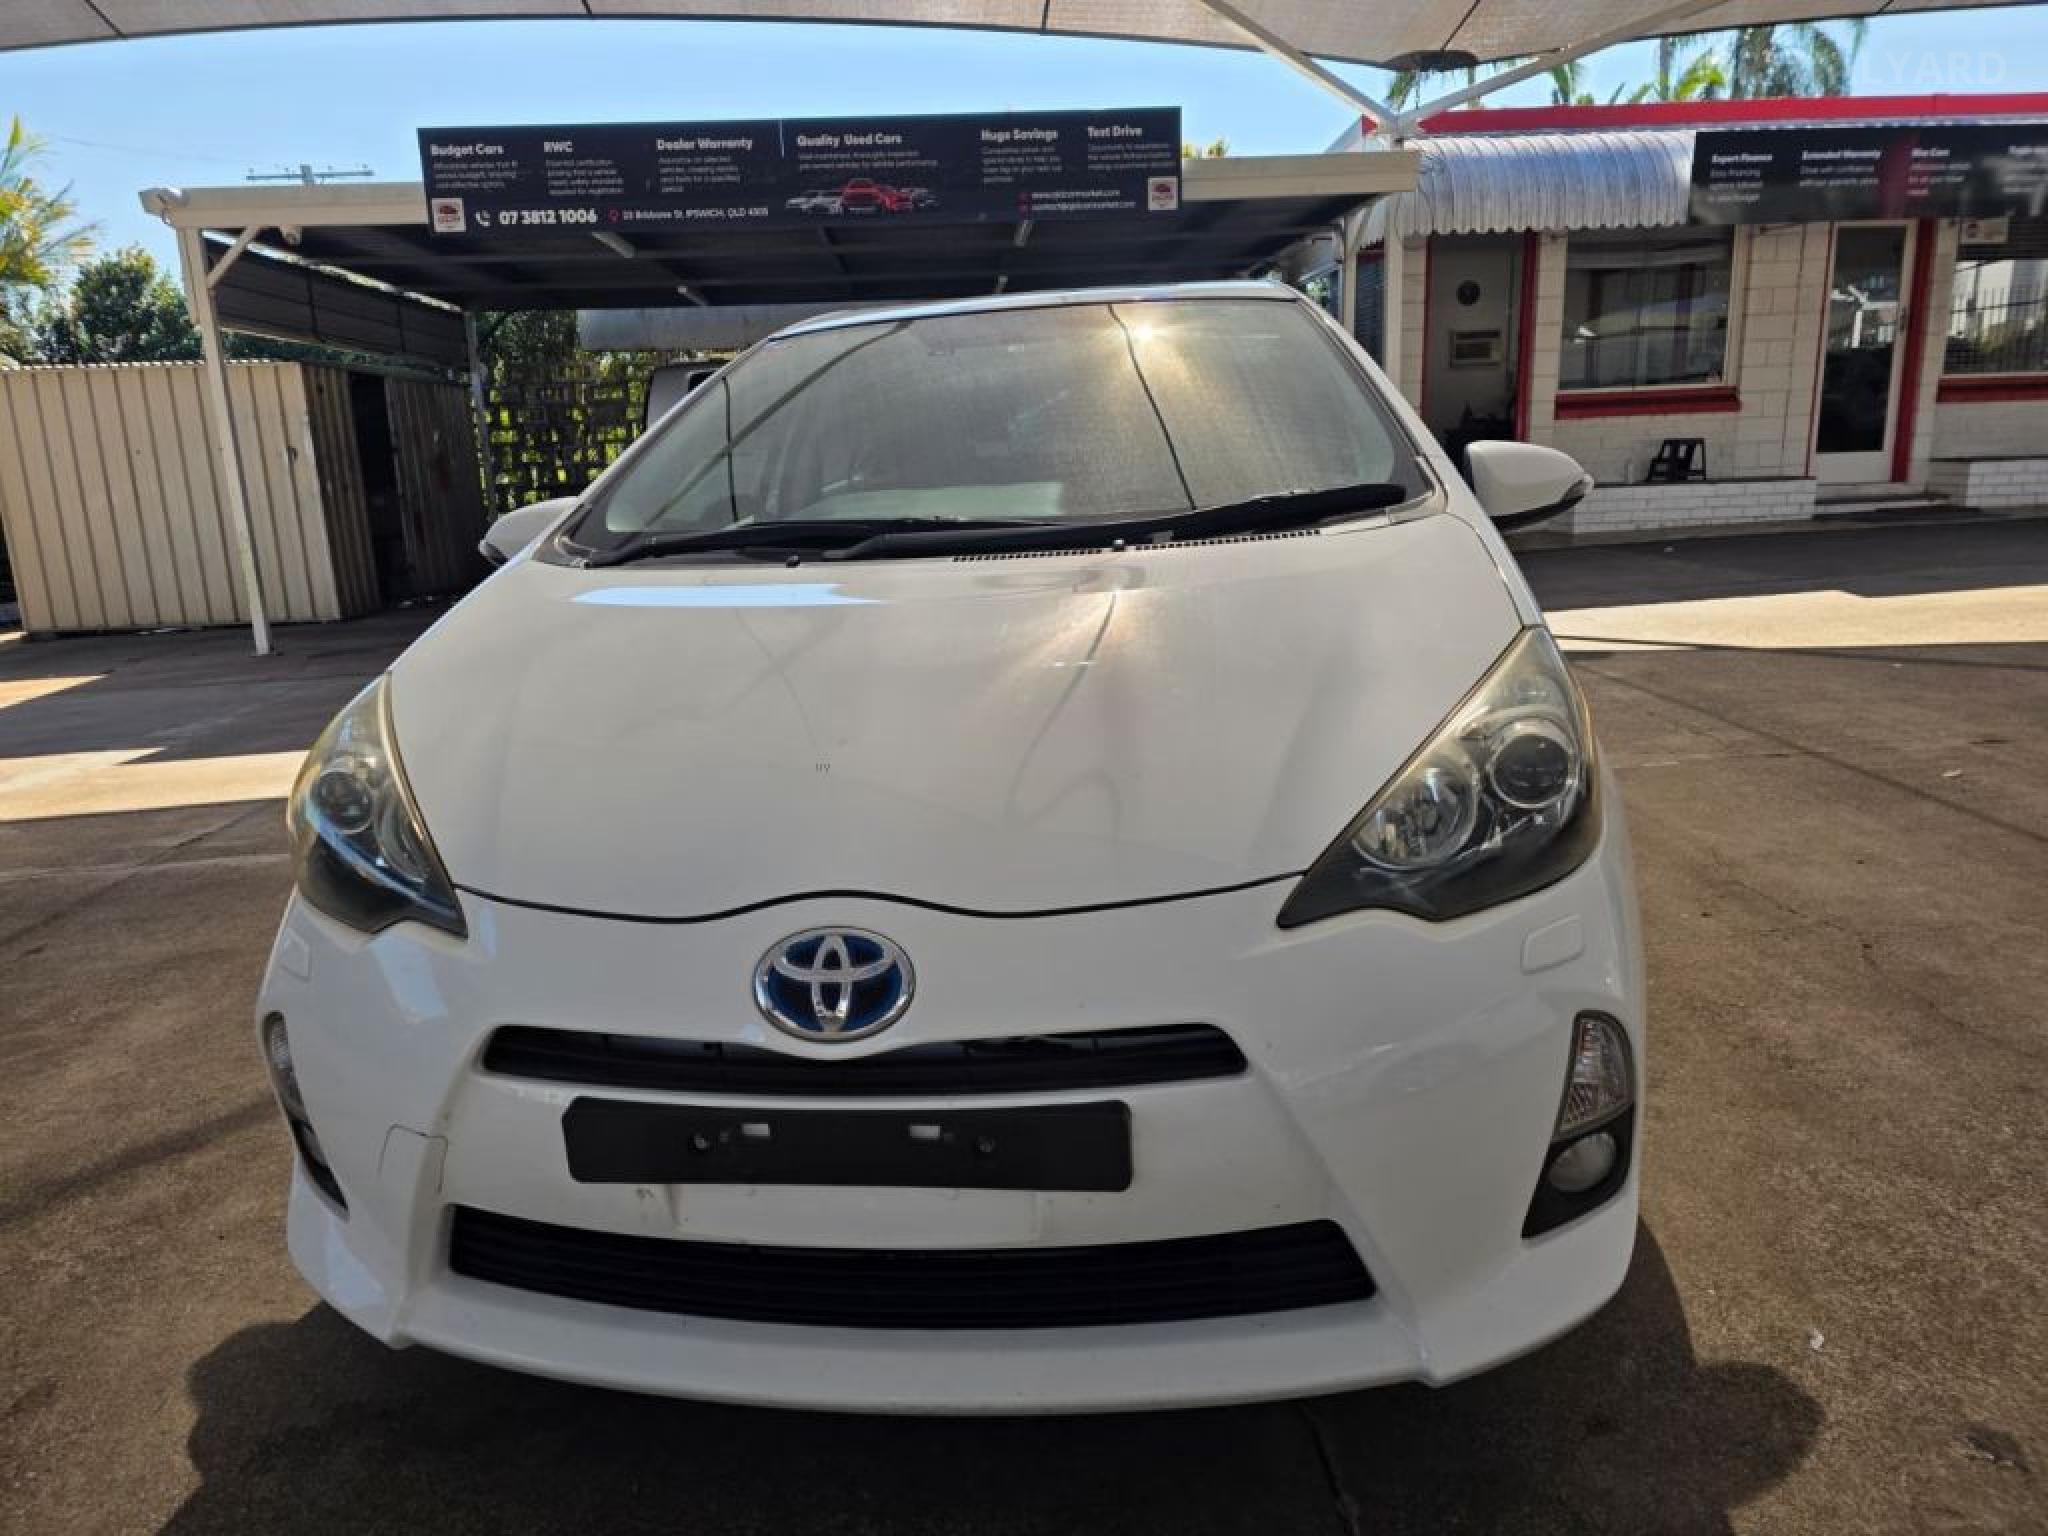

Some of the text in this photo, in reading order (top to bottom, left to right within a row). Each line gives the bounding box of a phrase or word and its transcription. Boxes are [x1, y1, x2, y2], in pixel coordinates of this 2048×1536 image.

[981, 128, 1058, 142] Huge Savings
[1087, 124, 1143, 137] Test Drive
[656, 137, 753, 151] Dealer Warranty
[796, 132, 903, 147] Quality Used Cars
[431, 143, 505, 158] Budget Cars
[543, 141, 574, 153] RWC
[499, 208, 598, 225] 07 3812 1006
